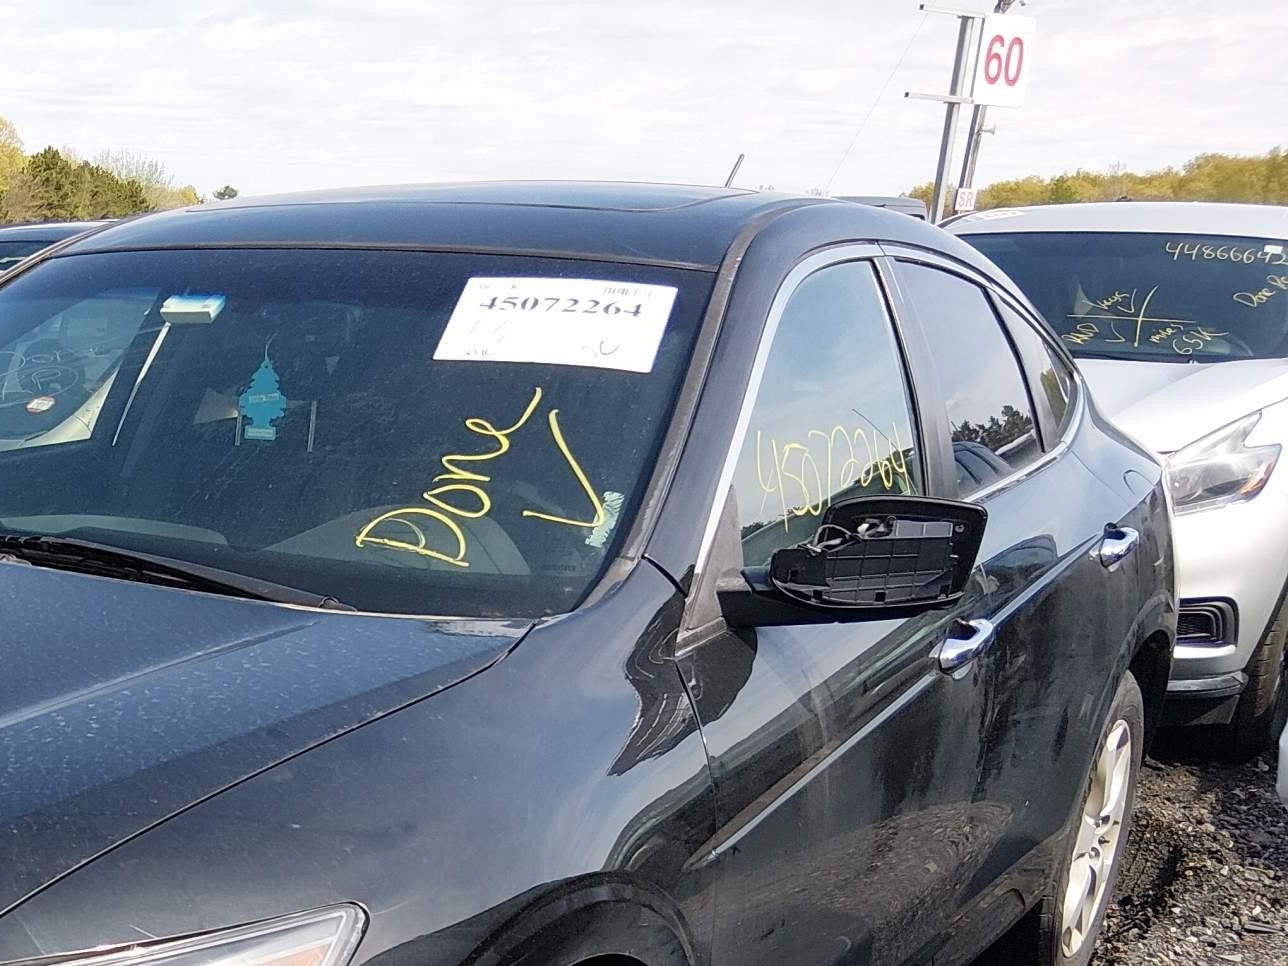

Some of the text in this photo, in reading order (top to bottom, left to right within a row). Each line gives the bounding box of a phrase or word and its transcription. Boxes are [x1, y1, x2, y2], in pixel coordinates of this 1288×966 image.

[984, 34, 1024, 87] 60
[479, 296, 642, 317] 45072264
[355, 386, 543, 568] Done
[756, 422, 912, 534] 45072264
